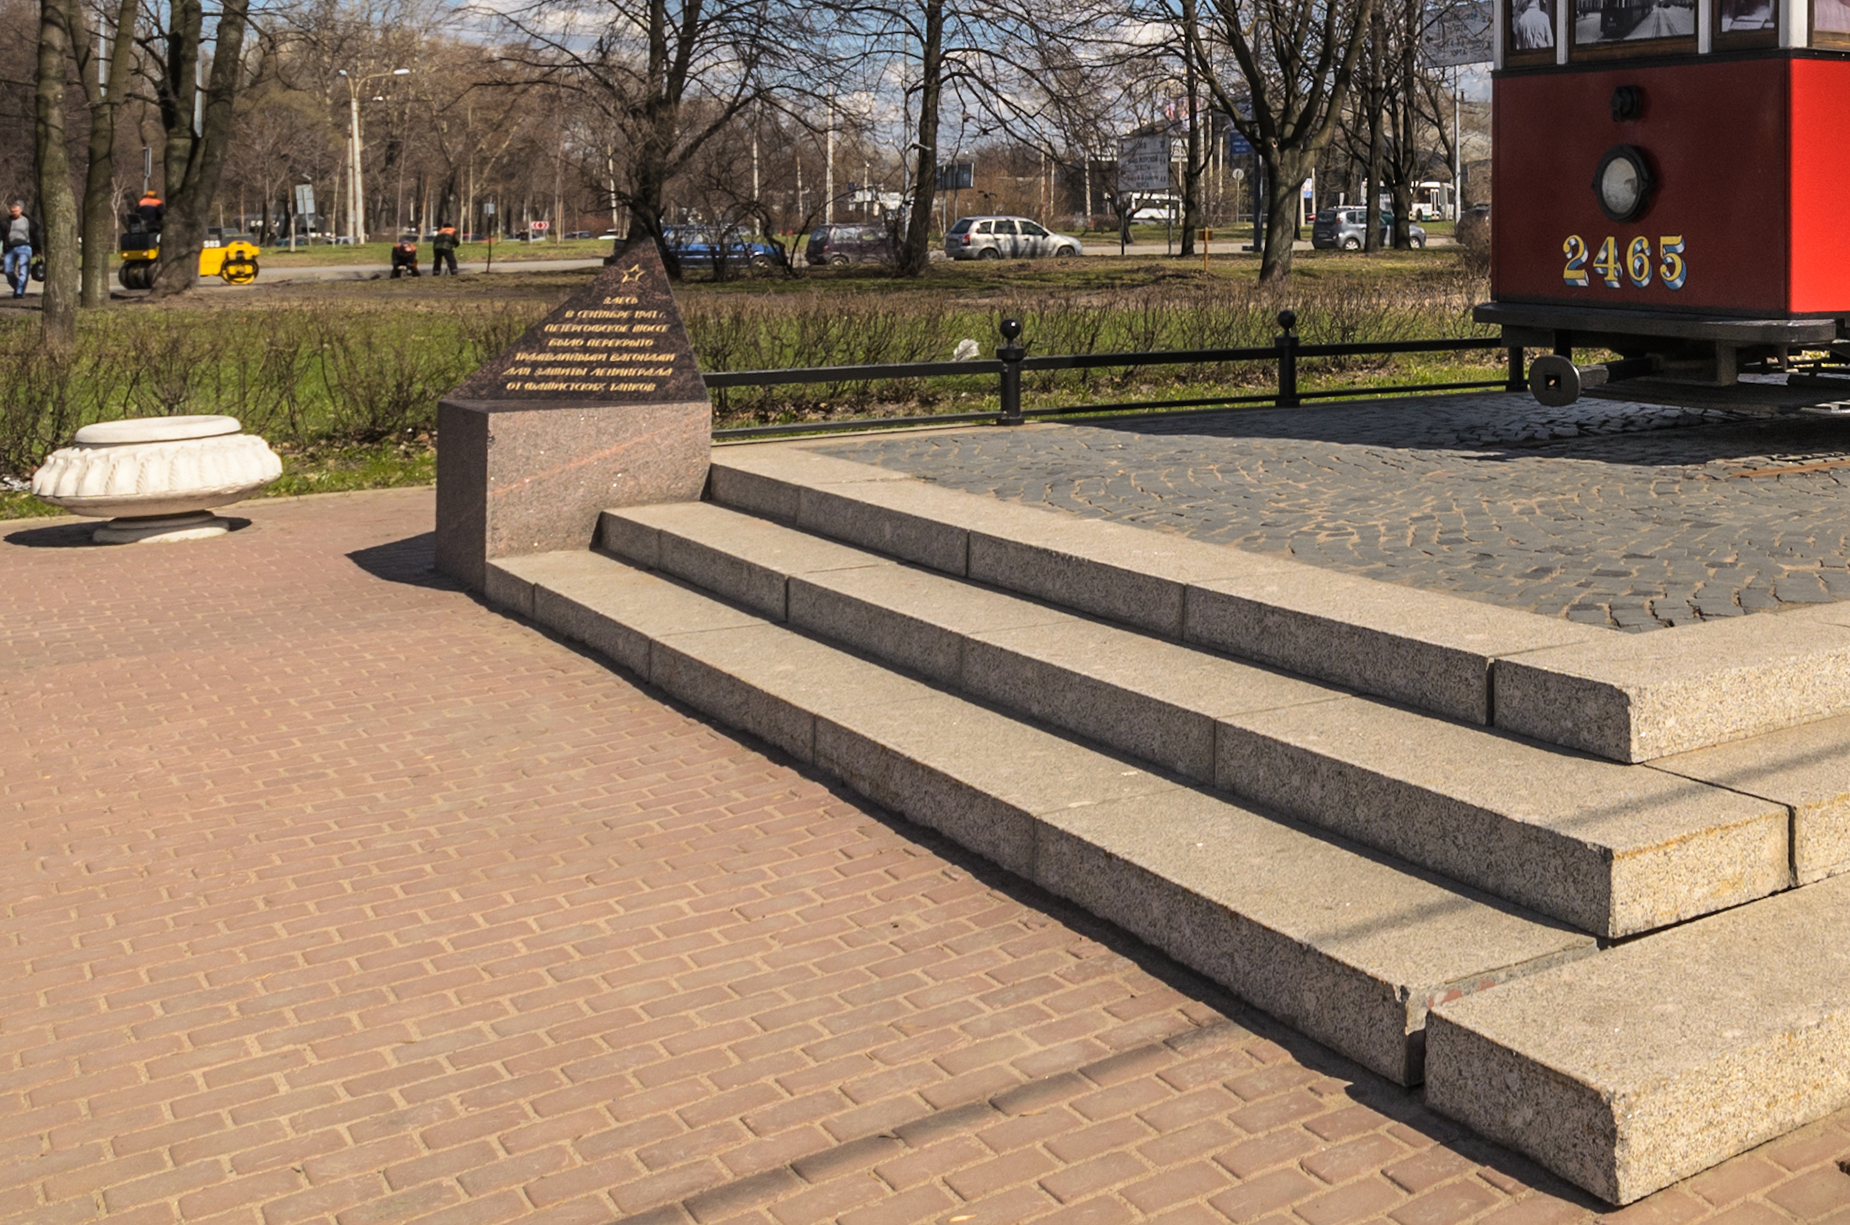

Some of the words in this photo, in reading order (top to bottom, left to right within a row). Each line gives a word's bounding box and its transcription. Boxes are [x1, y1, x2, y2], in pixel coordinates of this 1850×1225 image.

[1562, 234, 1687, 291] 2465
[603, 296, 639, 305] ЗДЕСЬ
[564, 310, 575, 319] В
[577, 310, 632, 319] СЕНТЯБРЕ
[634, 310, 658, 319] 1941
[544, 323, 631, 332] ПЕТЕРГОФСКОЕ
[632, 324, 671, 333] ШОССЕ
[548, 338, 584, 347] БЫЛО
[586, 338, 654, 347] ПЕРЕКРЫТО
[515, 352, 607, 362] ТРАМВАЙНЫМИ
[609, 353, 676, 362] ВАГОНАМИ
[502, 367, 532, 376] ДЛЯ
[534, 367, 588, 376] ЗАЩИТЫ
[589, 367, 673, 377] ЛЕНИНГРАДА
[506, 381, 522, 391] ОТ
[524, 381, 607, 392] ФАШИСТСКИХ
[609, 382, 656, 392] ТАНКОВ
